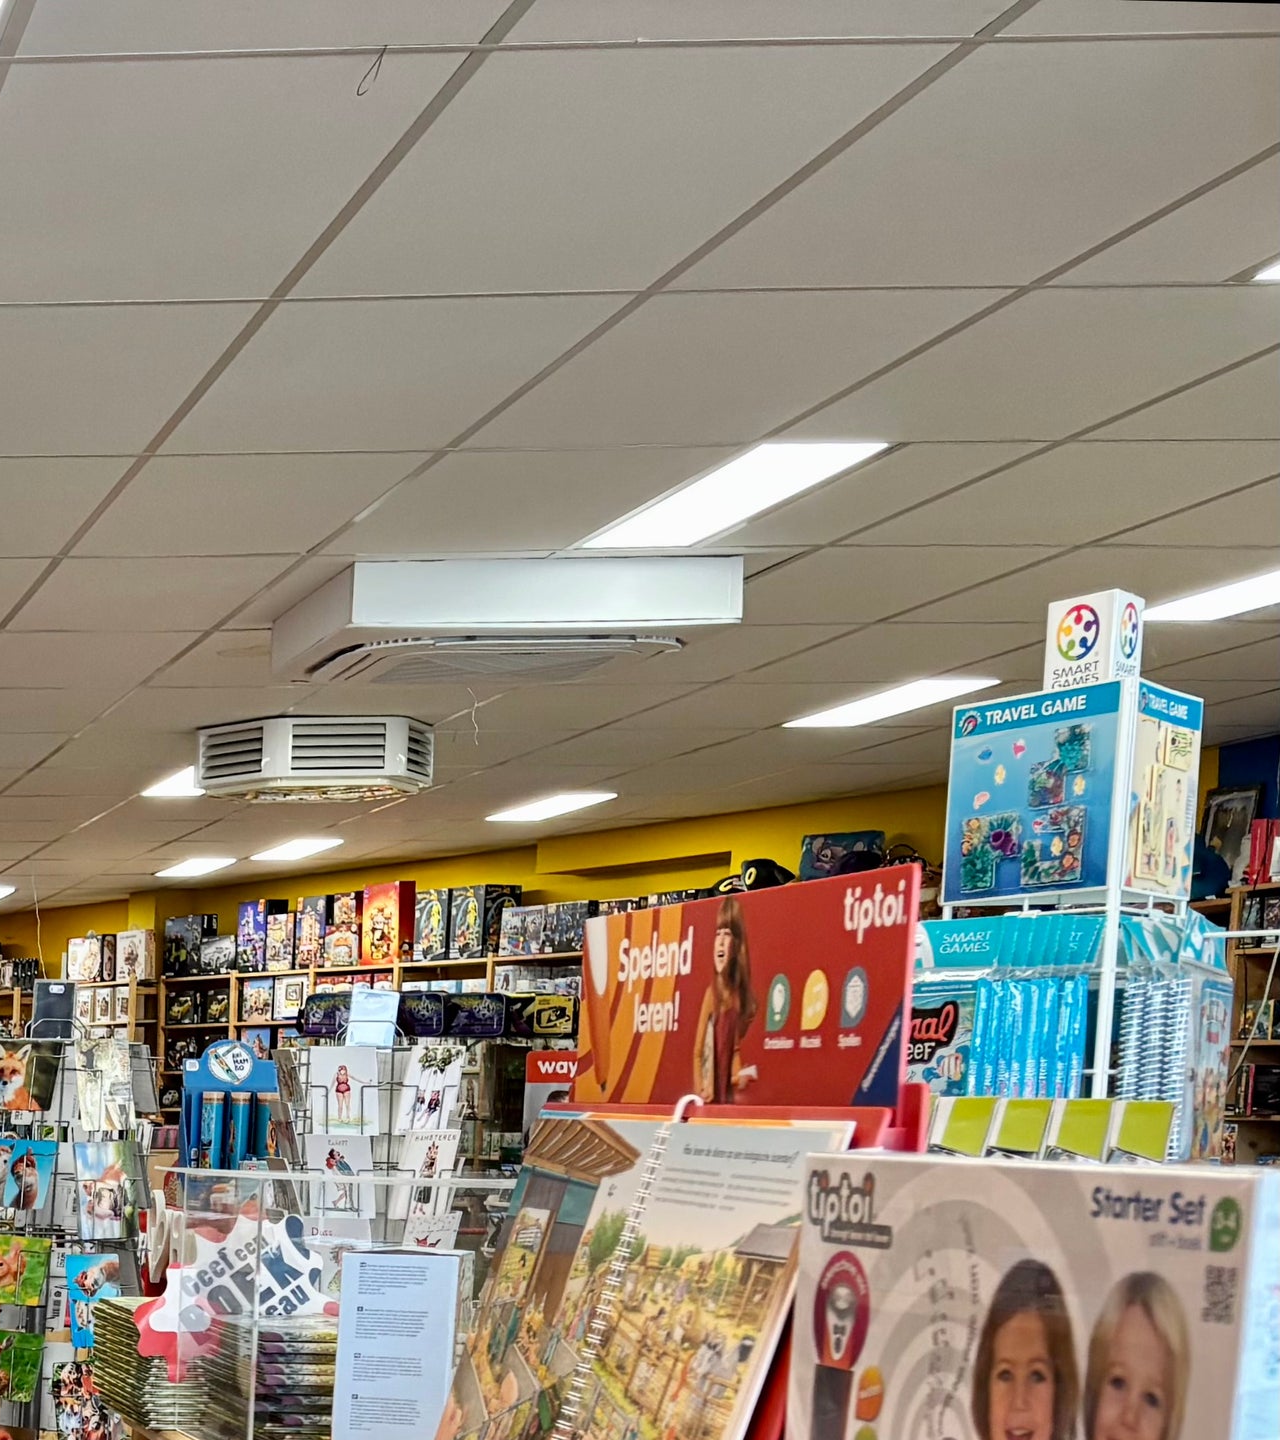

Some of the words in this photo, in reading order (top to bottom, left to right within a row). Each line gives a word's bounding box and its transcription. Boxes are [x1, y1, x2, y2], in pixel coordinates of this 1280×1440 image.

[1052, 662, 1100, 678] SMART
[984, 704, 1039, 726] TRAVEL
[1041, 694, 1088, 716] GAME
[844, 879, 908, 943] tiptoi
[940, 943, 990, 953] GAMES
[942, 931, 991, 942] SMART
[617, 928, 694, 985] Spelend
[632, 988, 680, 1034] leren!
[415, 1134, 458, 1142] HAMSTEREN
[808, 1170, 878, 1241] tiptoi
[1091, 1186, 1163, 1222] Starter
[1171, 1192, 1206, 1226] Set
